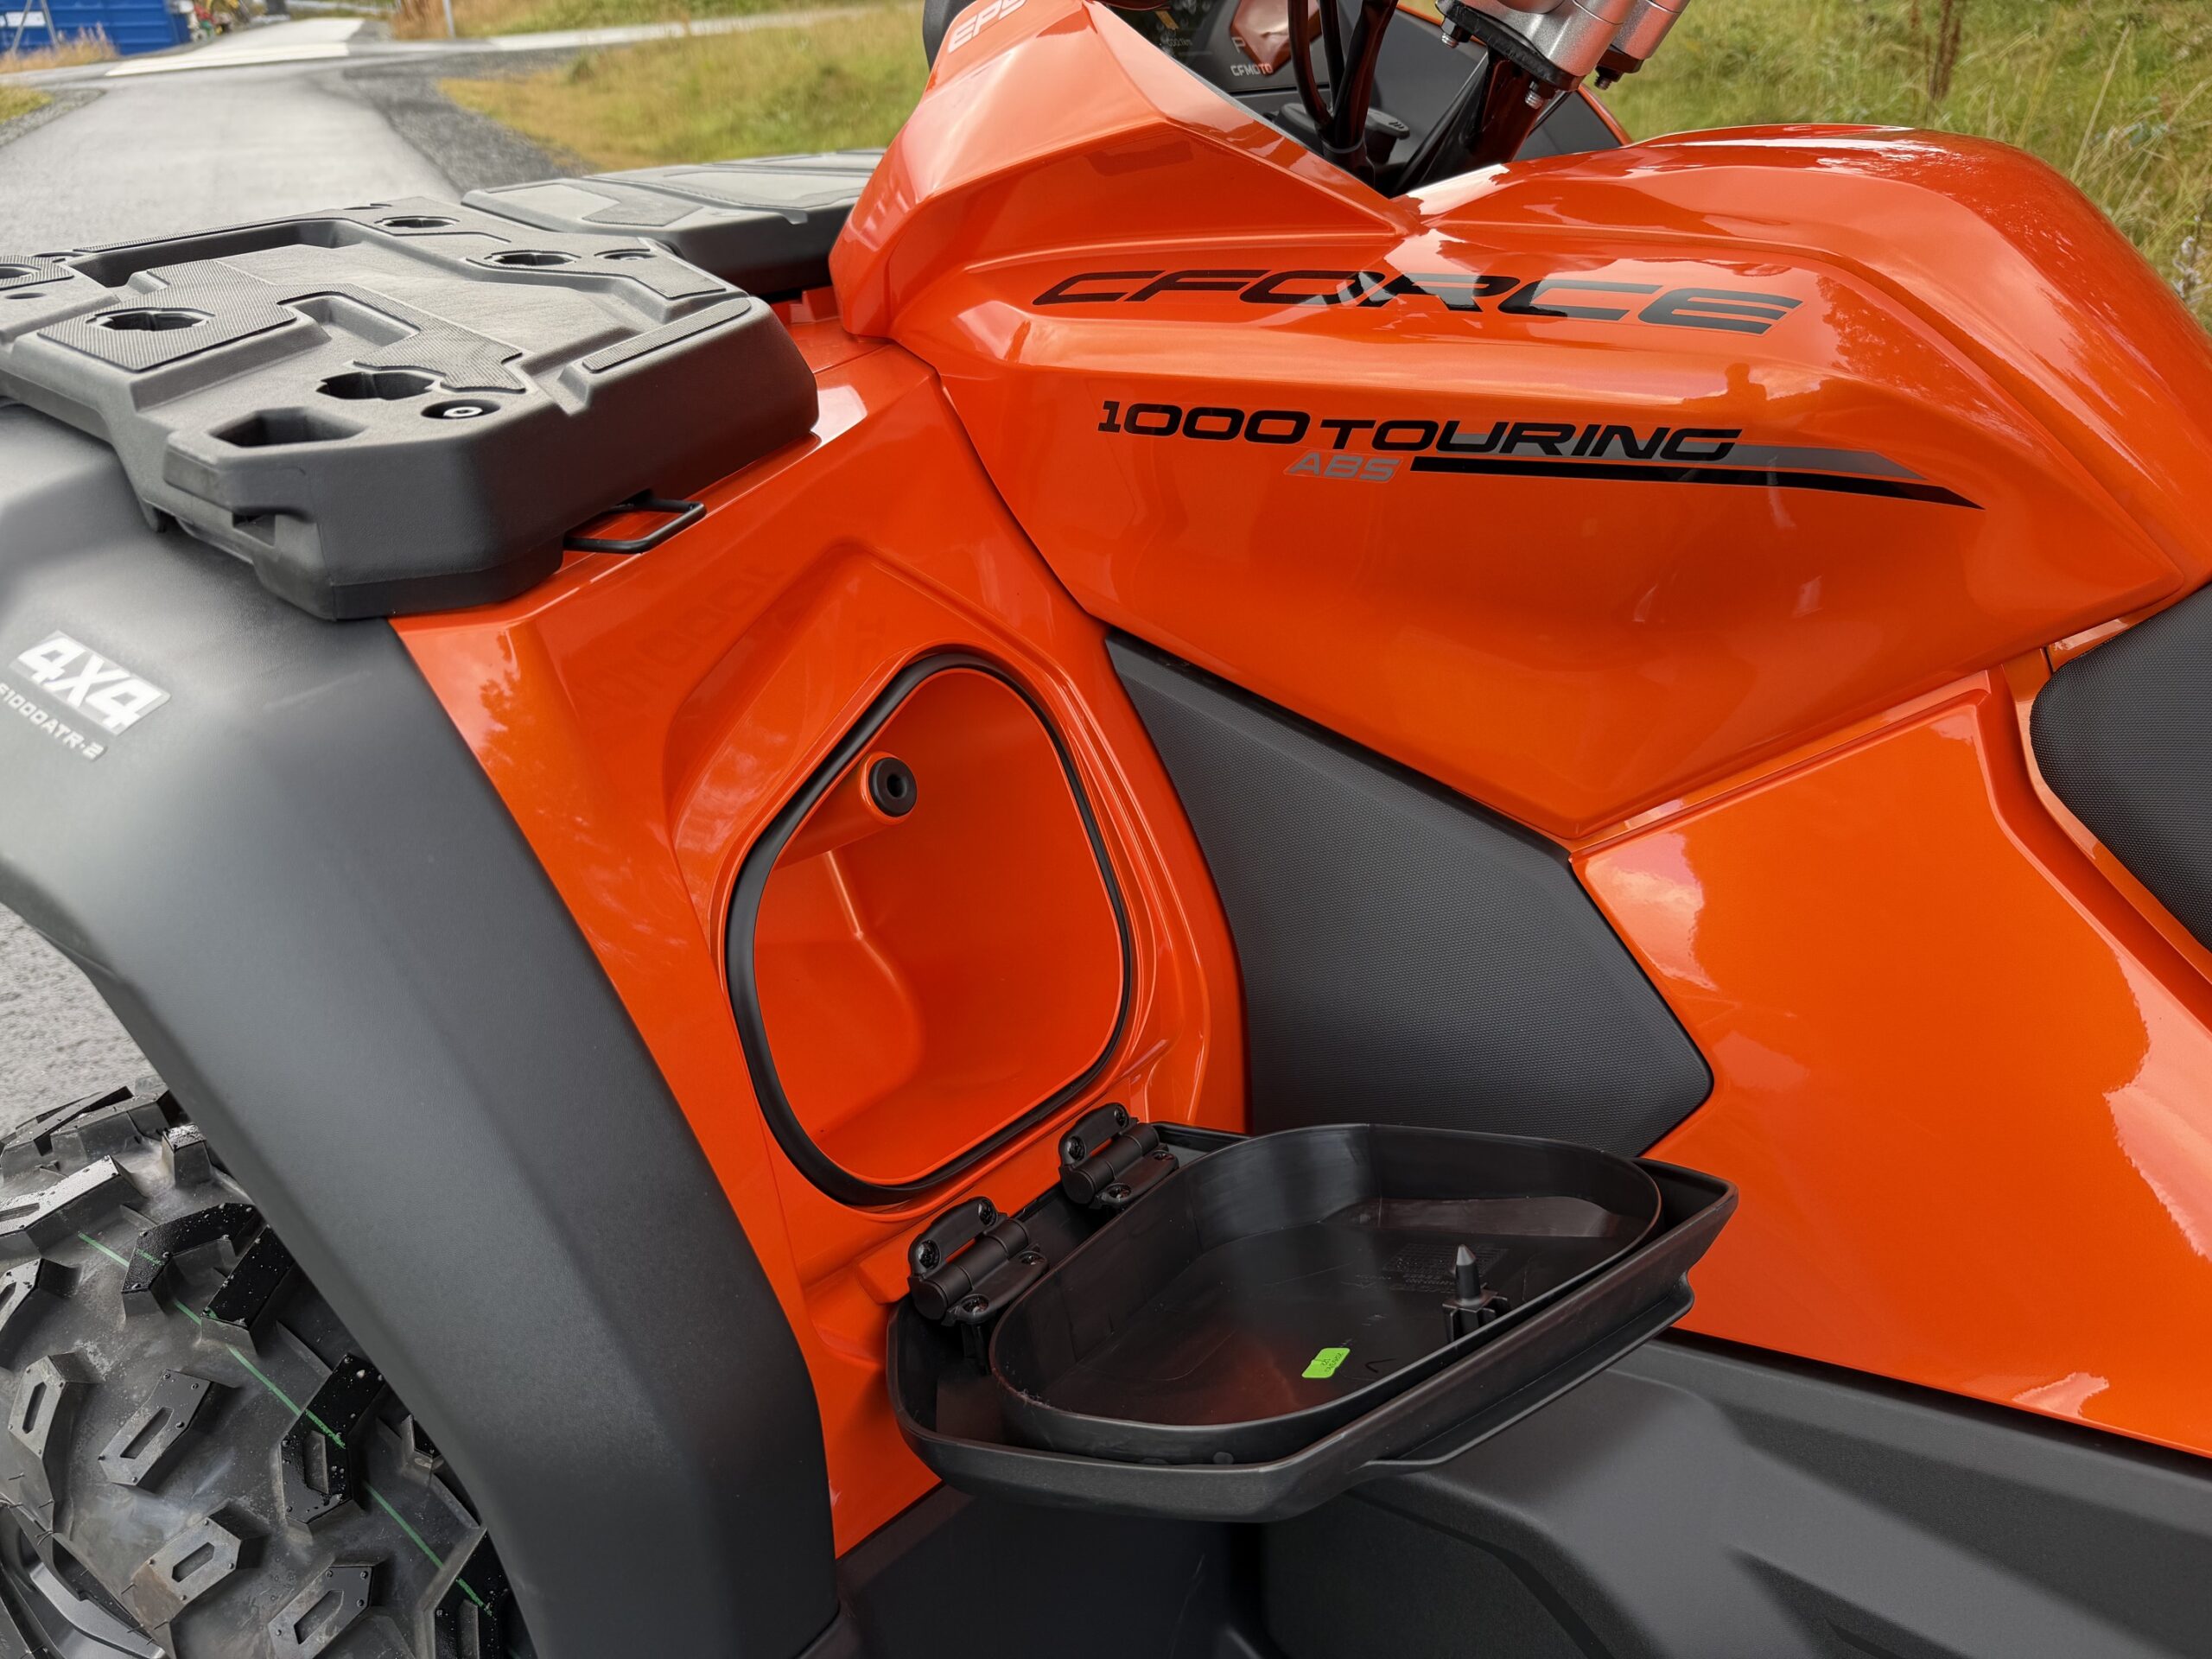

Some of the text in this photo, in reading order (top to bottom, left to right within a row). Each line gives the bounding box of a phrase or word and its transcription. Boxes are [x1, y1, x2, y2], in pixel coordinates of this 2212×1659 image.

[1230, 63, 1274, 77] CFMOTO
[1033, 270, 1803, 334] CFORCE
[1097, 400, 1743, 461] 1000 TOURING
[1287, 452, 1402, 482] ABS
[17, 637, 163, 729] 4X4
